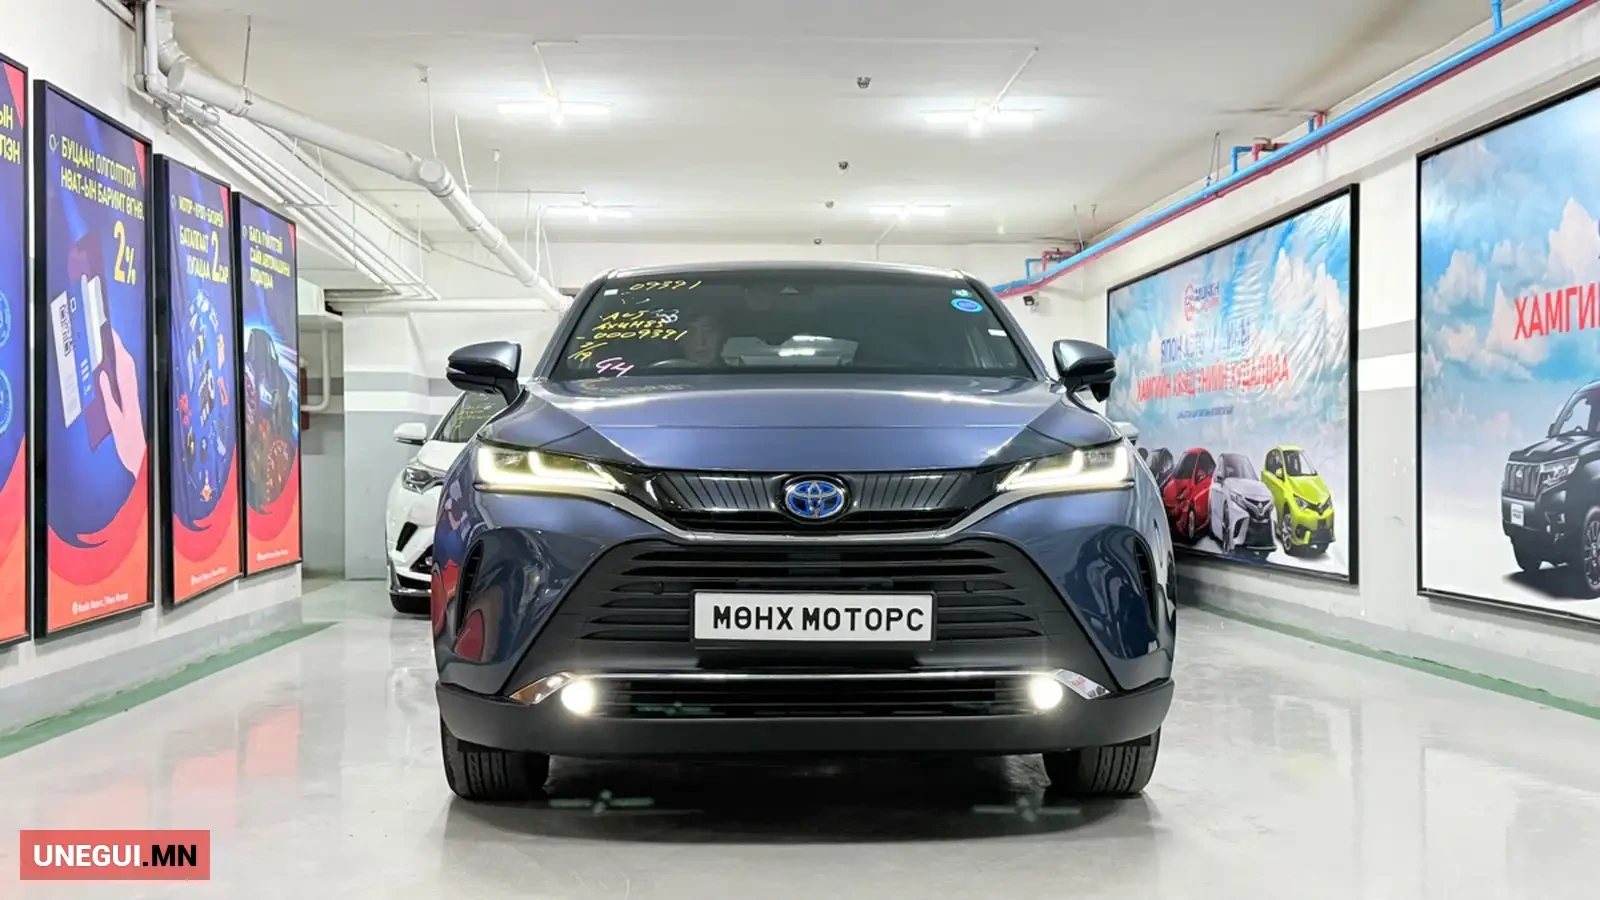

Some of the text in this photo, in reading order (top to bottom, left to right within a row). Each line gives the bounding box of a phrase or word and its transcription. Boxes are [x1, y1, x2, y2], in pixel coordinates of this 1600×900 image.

[61, 136, 95, 171] БУЦААН
[97, 182, 125, 213] БАРИМТ
[113, 220, 137, 286] 2%
[1513, 282, 1600, 340] ХАМГИ
[713, 605, 924, 632] МӨНХ МОТОРС
